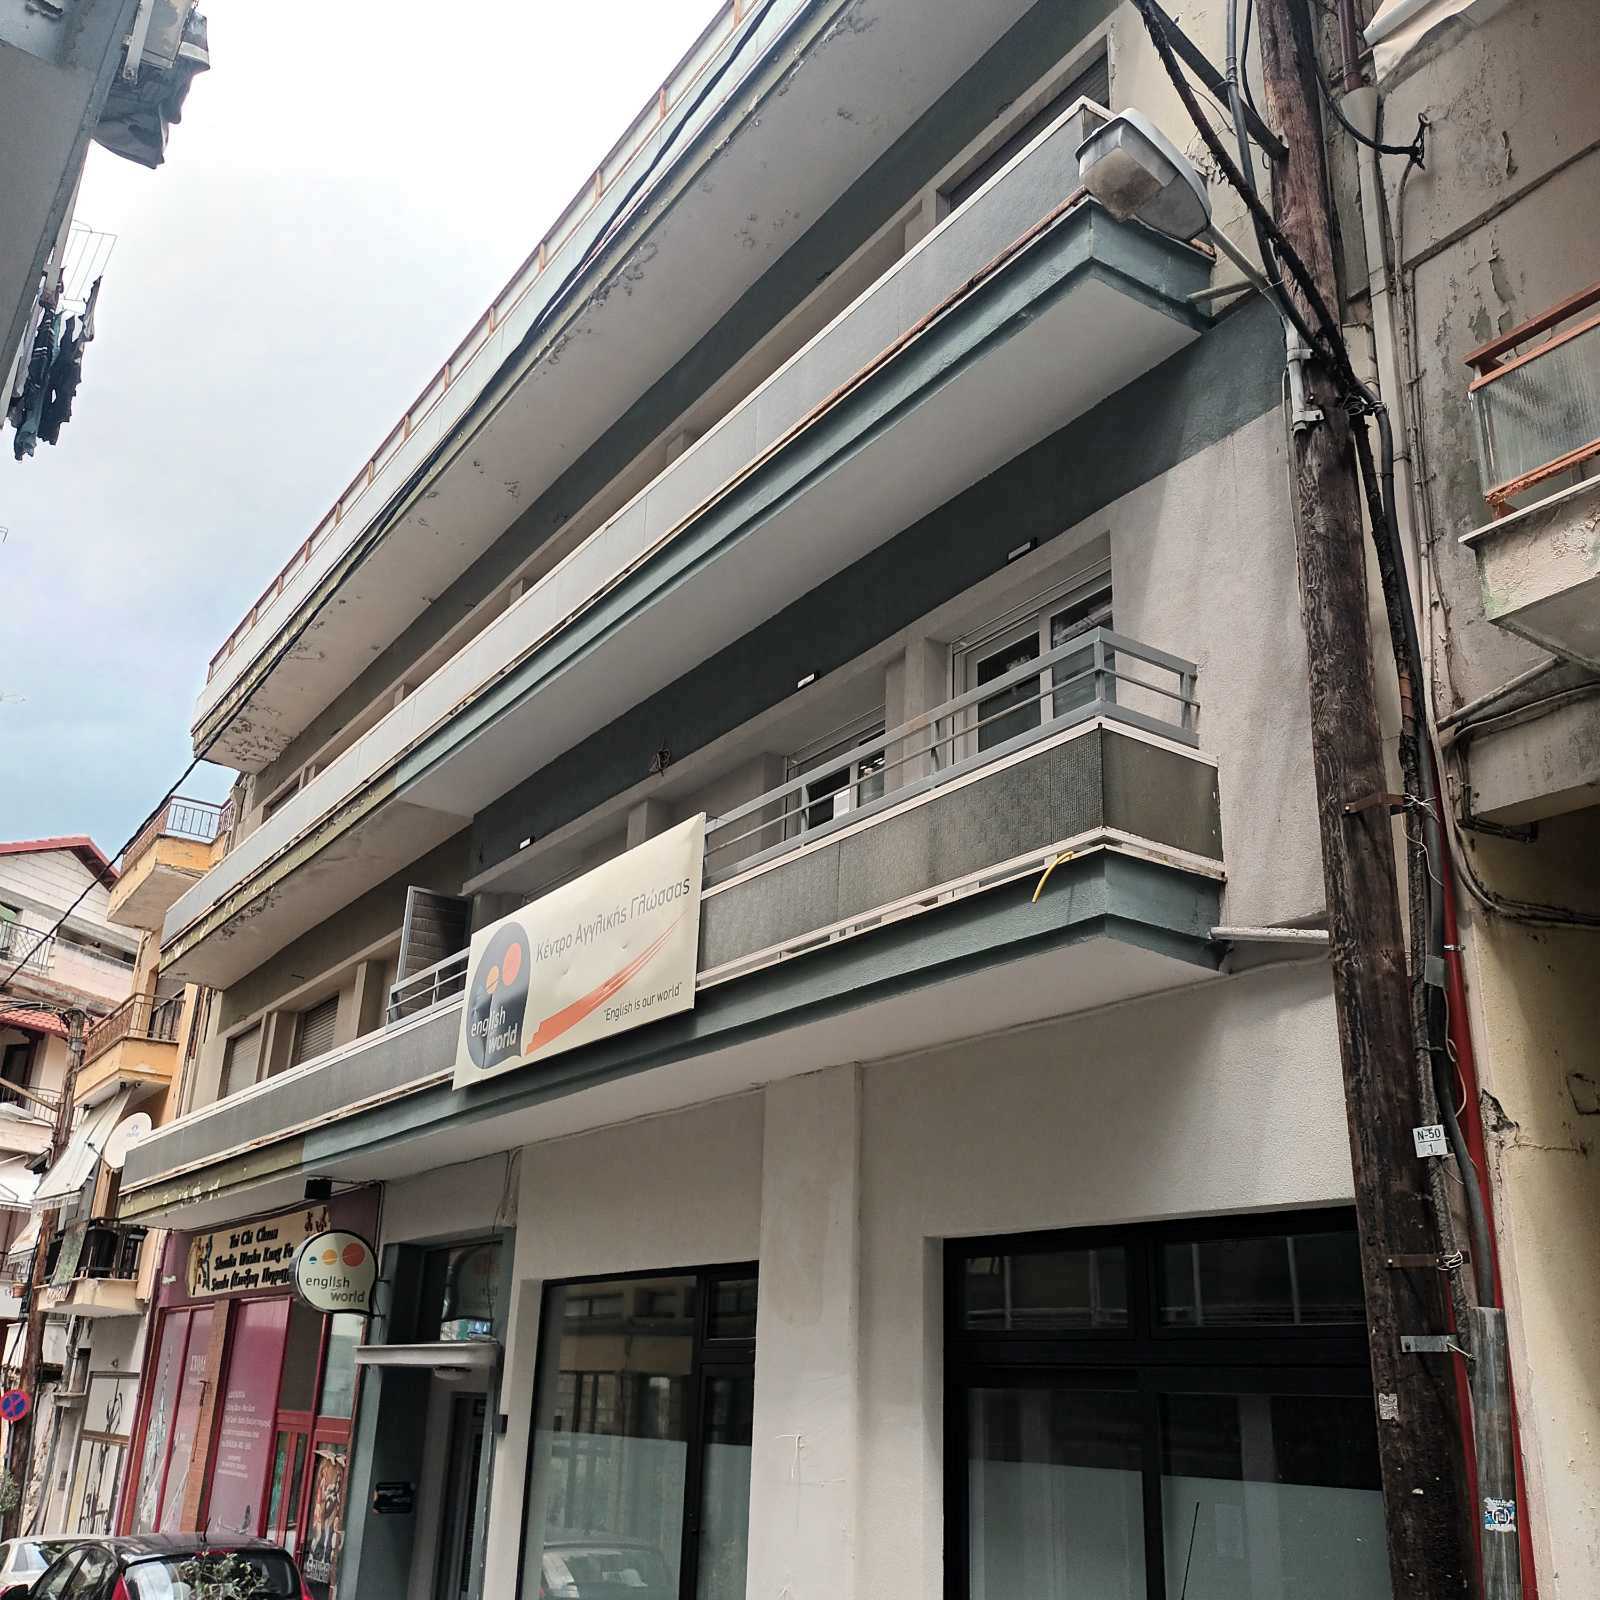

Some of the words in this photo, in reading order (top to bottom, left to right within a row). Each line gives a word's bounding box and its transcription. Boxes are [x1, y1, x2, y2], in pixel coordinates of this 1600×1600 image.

[536, 933, 573, 962] Κέντρο
[575, 904, 627, 945] Αγγλικής
[630, 878, 690, 920] Γλώσσας
[634, 997, 641, 1010] is
[642, 994, 656, 1008] our
[471, 1005, 506, 1037] english
[488, 1022, 518, 1054] world
[1417, 1128, 1441, 1141] N-50
[241, 1229, 254, 1246] Chi
[262, 1246, 283, 1264] Kung
[283, 1242, 295, 1259] Fu
[305, 1275, 350, 1290] english
[330, 1290, 366, 1303] world
